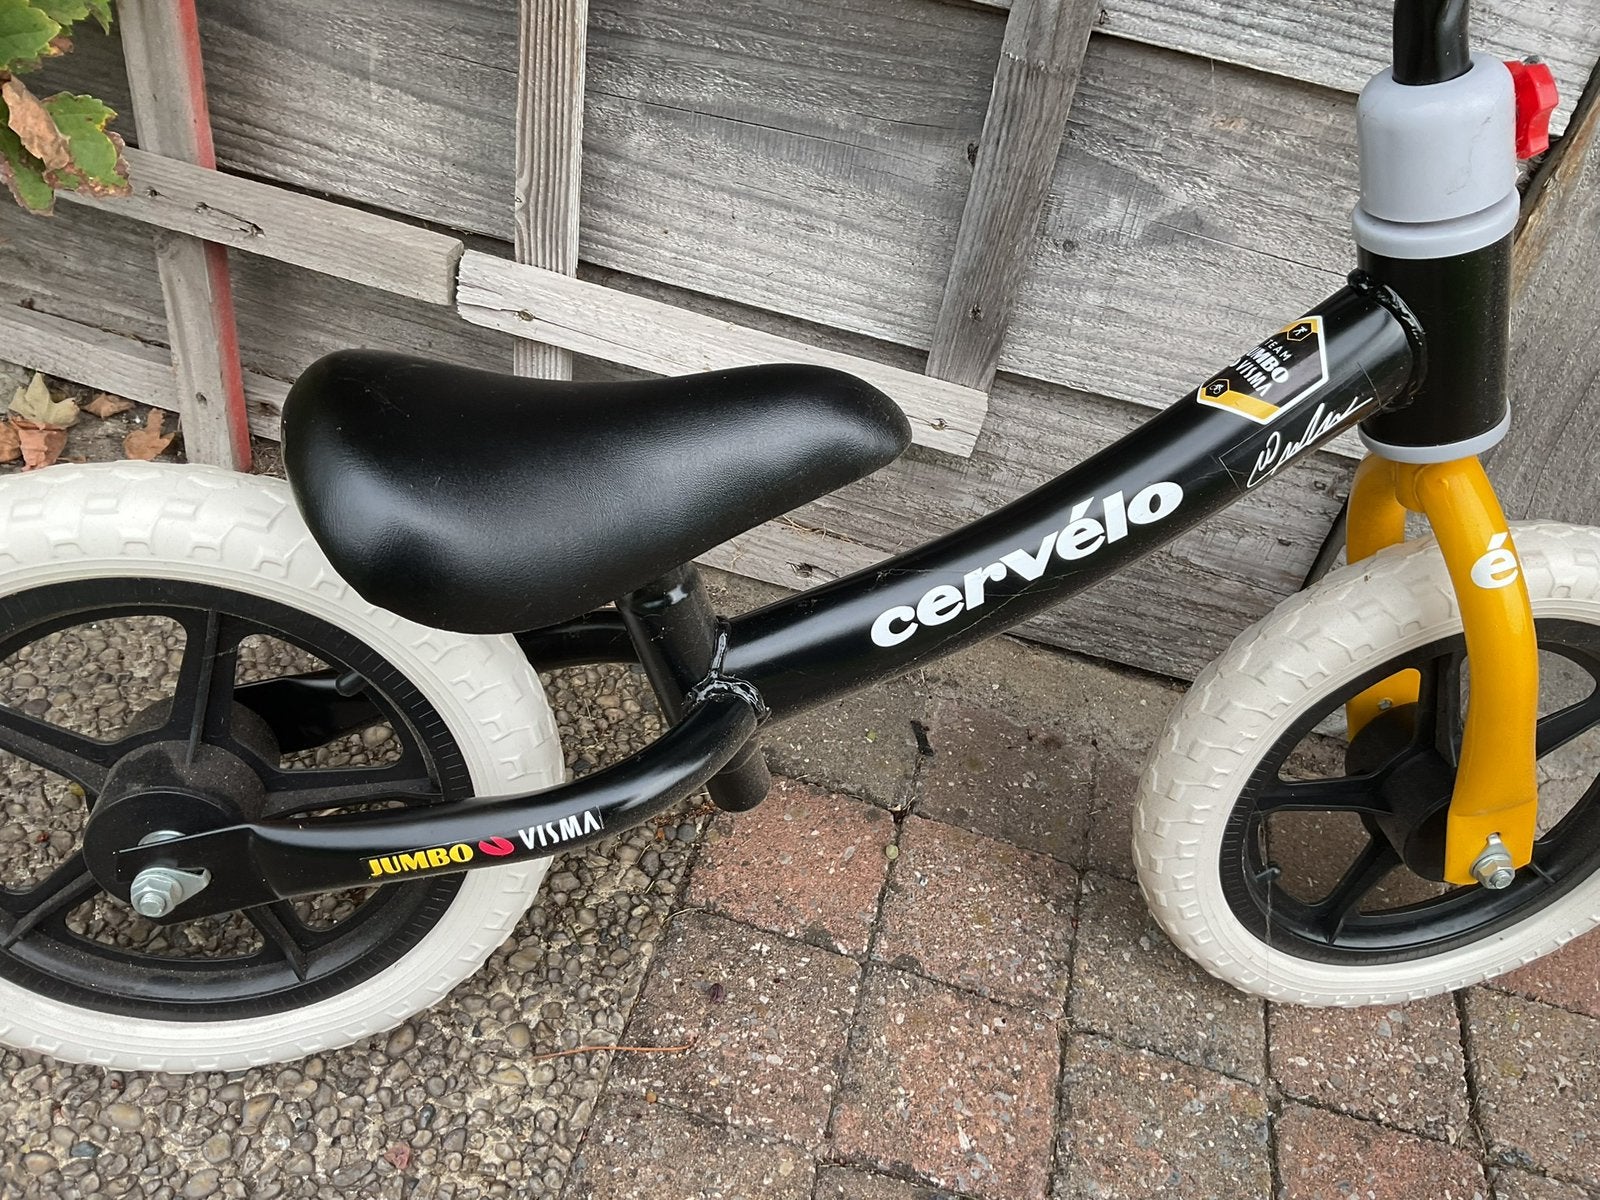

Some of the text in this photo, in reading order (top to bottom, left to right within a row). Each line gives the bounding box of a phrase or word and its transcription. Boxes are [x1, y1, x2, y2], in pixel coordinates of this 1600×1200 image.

[1235, 360, 1273, 397] VISMA
[1264, 339, 1292, 361] TEAM
[870, 481, 1184, 648] cervélo
[1470, 531, 1519, 589] é
[368, 810, 601, 877] JUMBO VISMA
